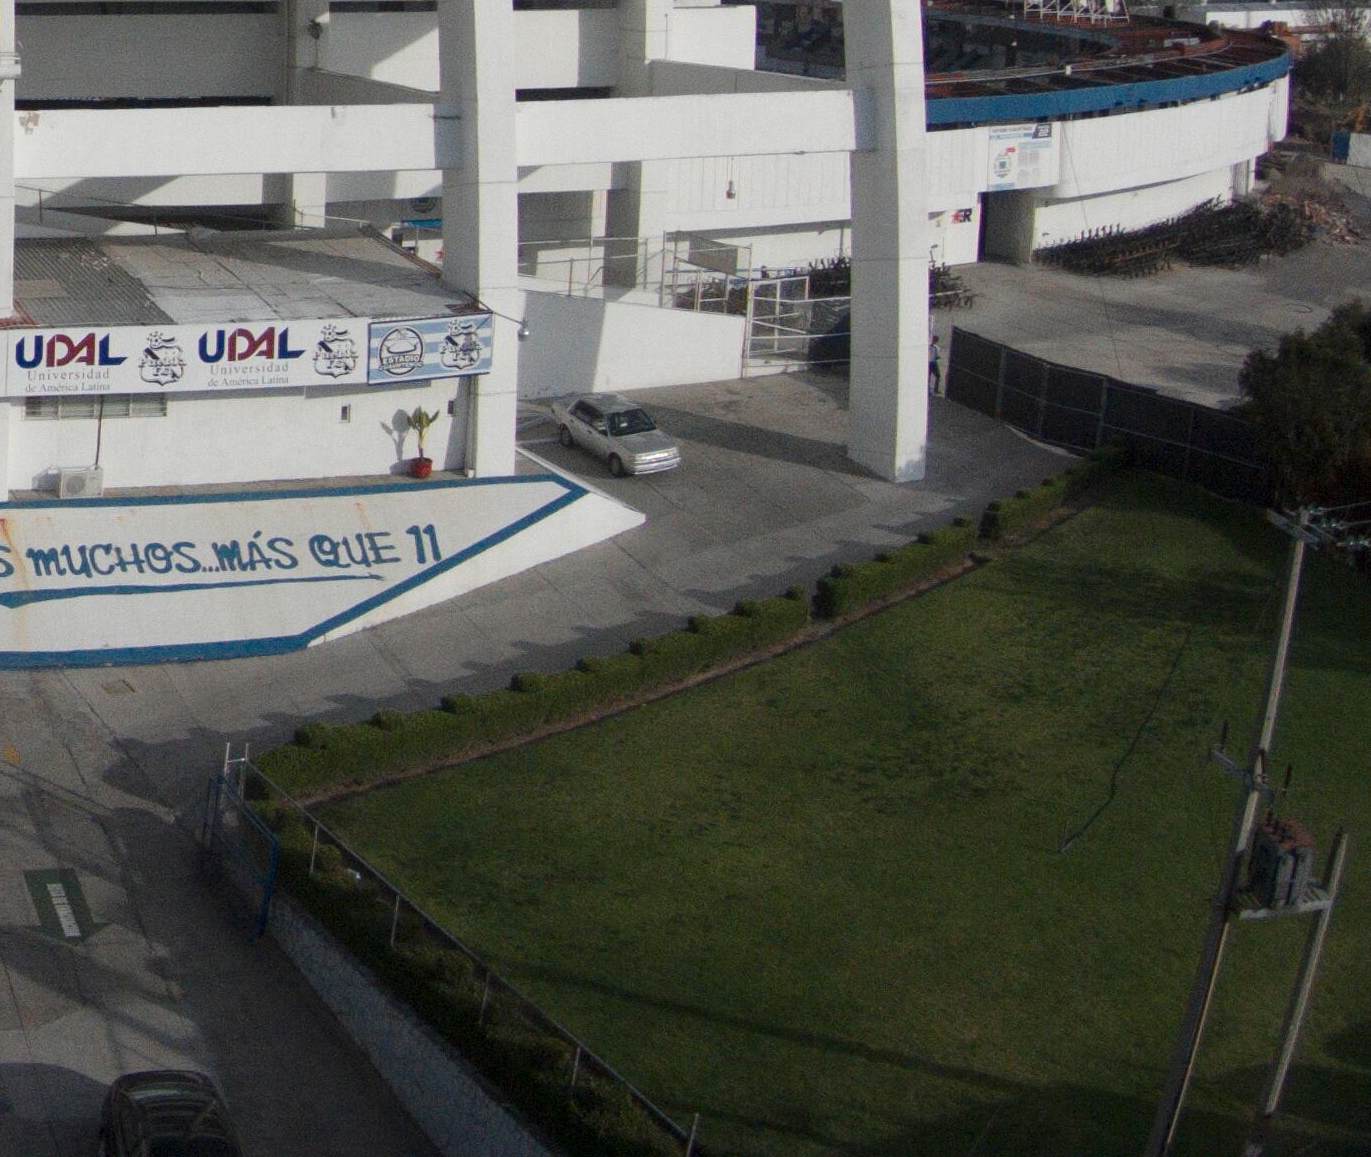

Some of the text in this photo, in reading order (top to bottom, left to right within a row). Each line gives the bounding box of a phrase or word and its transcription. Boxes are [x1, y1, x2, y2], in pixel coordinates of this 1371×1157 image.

[15, 332, 128, 369] UDAL
[198, 326, 306, 363] UDAL
[27, 369, 109, 381] Universidad
[210, 362, 288, 376] Universidad
[25, 381, 110, 392] de América Latina
[208, 374, 289, 387] de América Latina
[309, 531, 402, 568] QUE
[405, 524, 442, 564] 11
